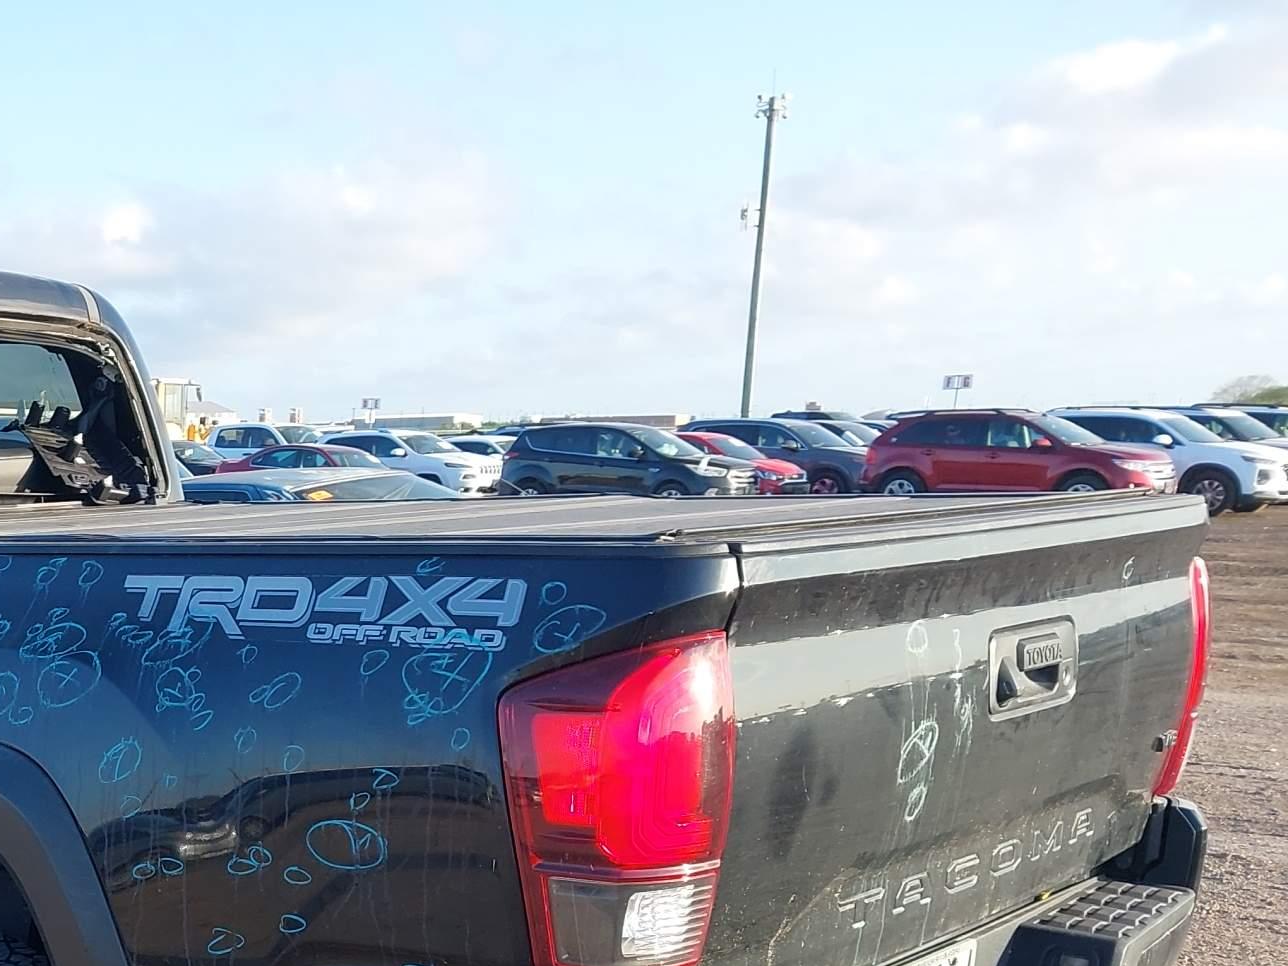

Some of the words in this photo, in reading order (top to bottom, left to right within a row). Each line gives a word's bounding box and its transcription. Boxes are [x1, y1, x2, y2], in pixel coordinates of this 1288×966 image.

[123, 574, 313, 640] TRD
[306, 623, 387, 645] OFF
[388, 626, 506, 651] ROAD
[1026, 642, 1063, 667] TOYOTA
[837, 808, 1094, 928] TACOMA
